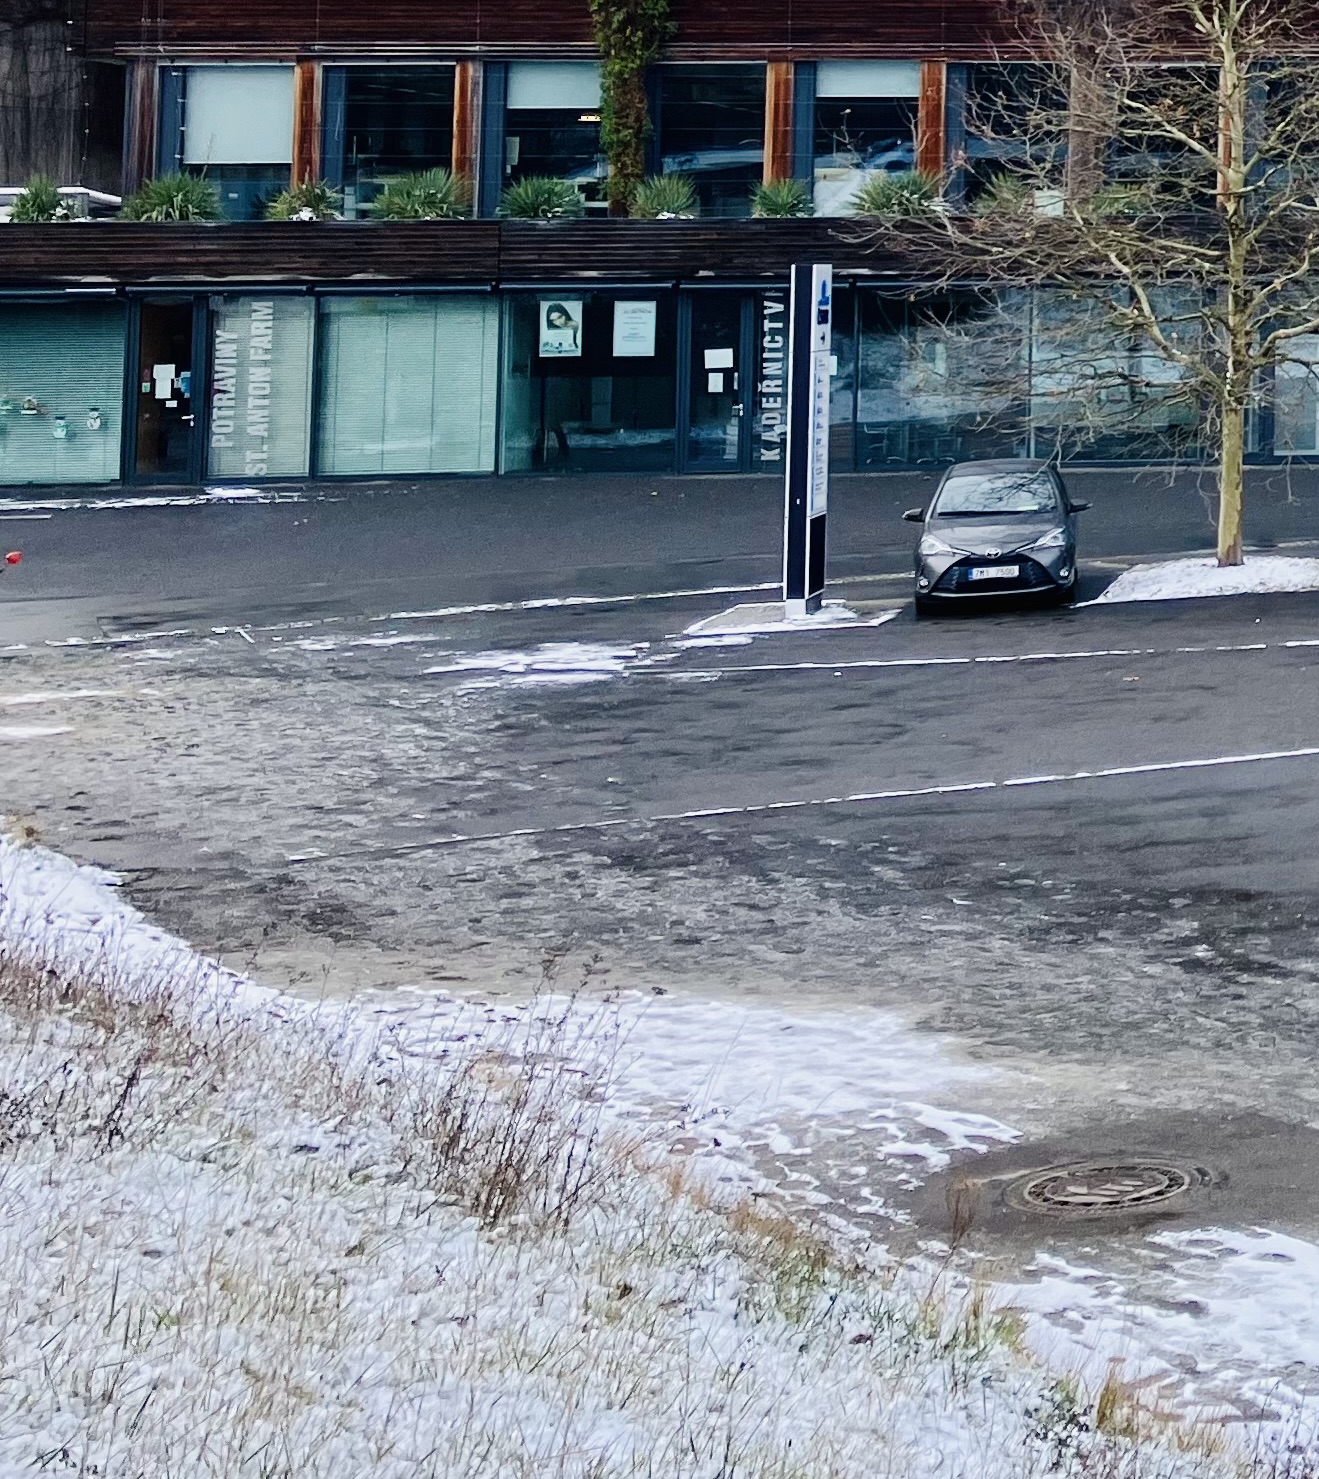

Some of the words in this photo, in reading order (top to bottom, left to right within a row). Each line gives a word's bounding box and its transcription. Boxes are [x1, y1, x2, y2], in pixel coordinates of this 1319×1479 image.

[250, 301, 274, 361] FARM
[211, 330, 238, 448] POTRAVINY
[246, 367, 272, 437] ANTON
[245, 445, 269, 476] ST.
